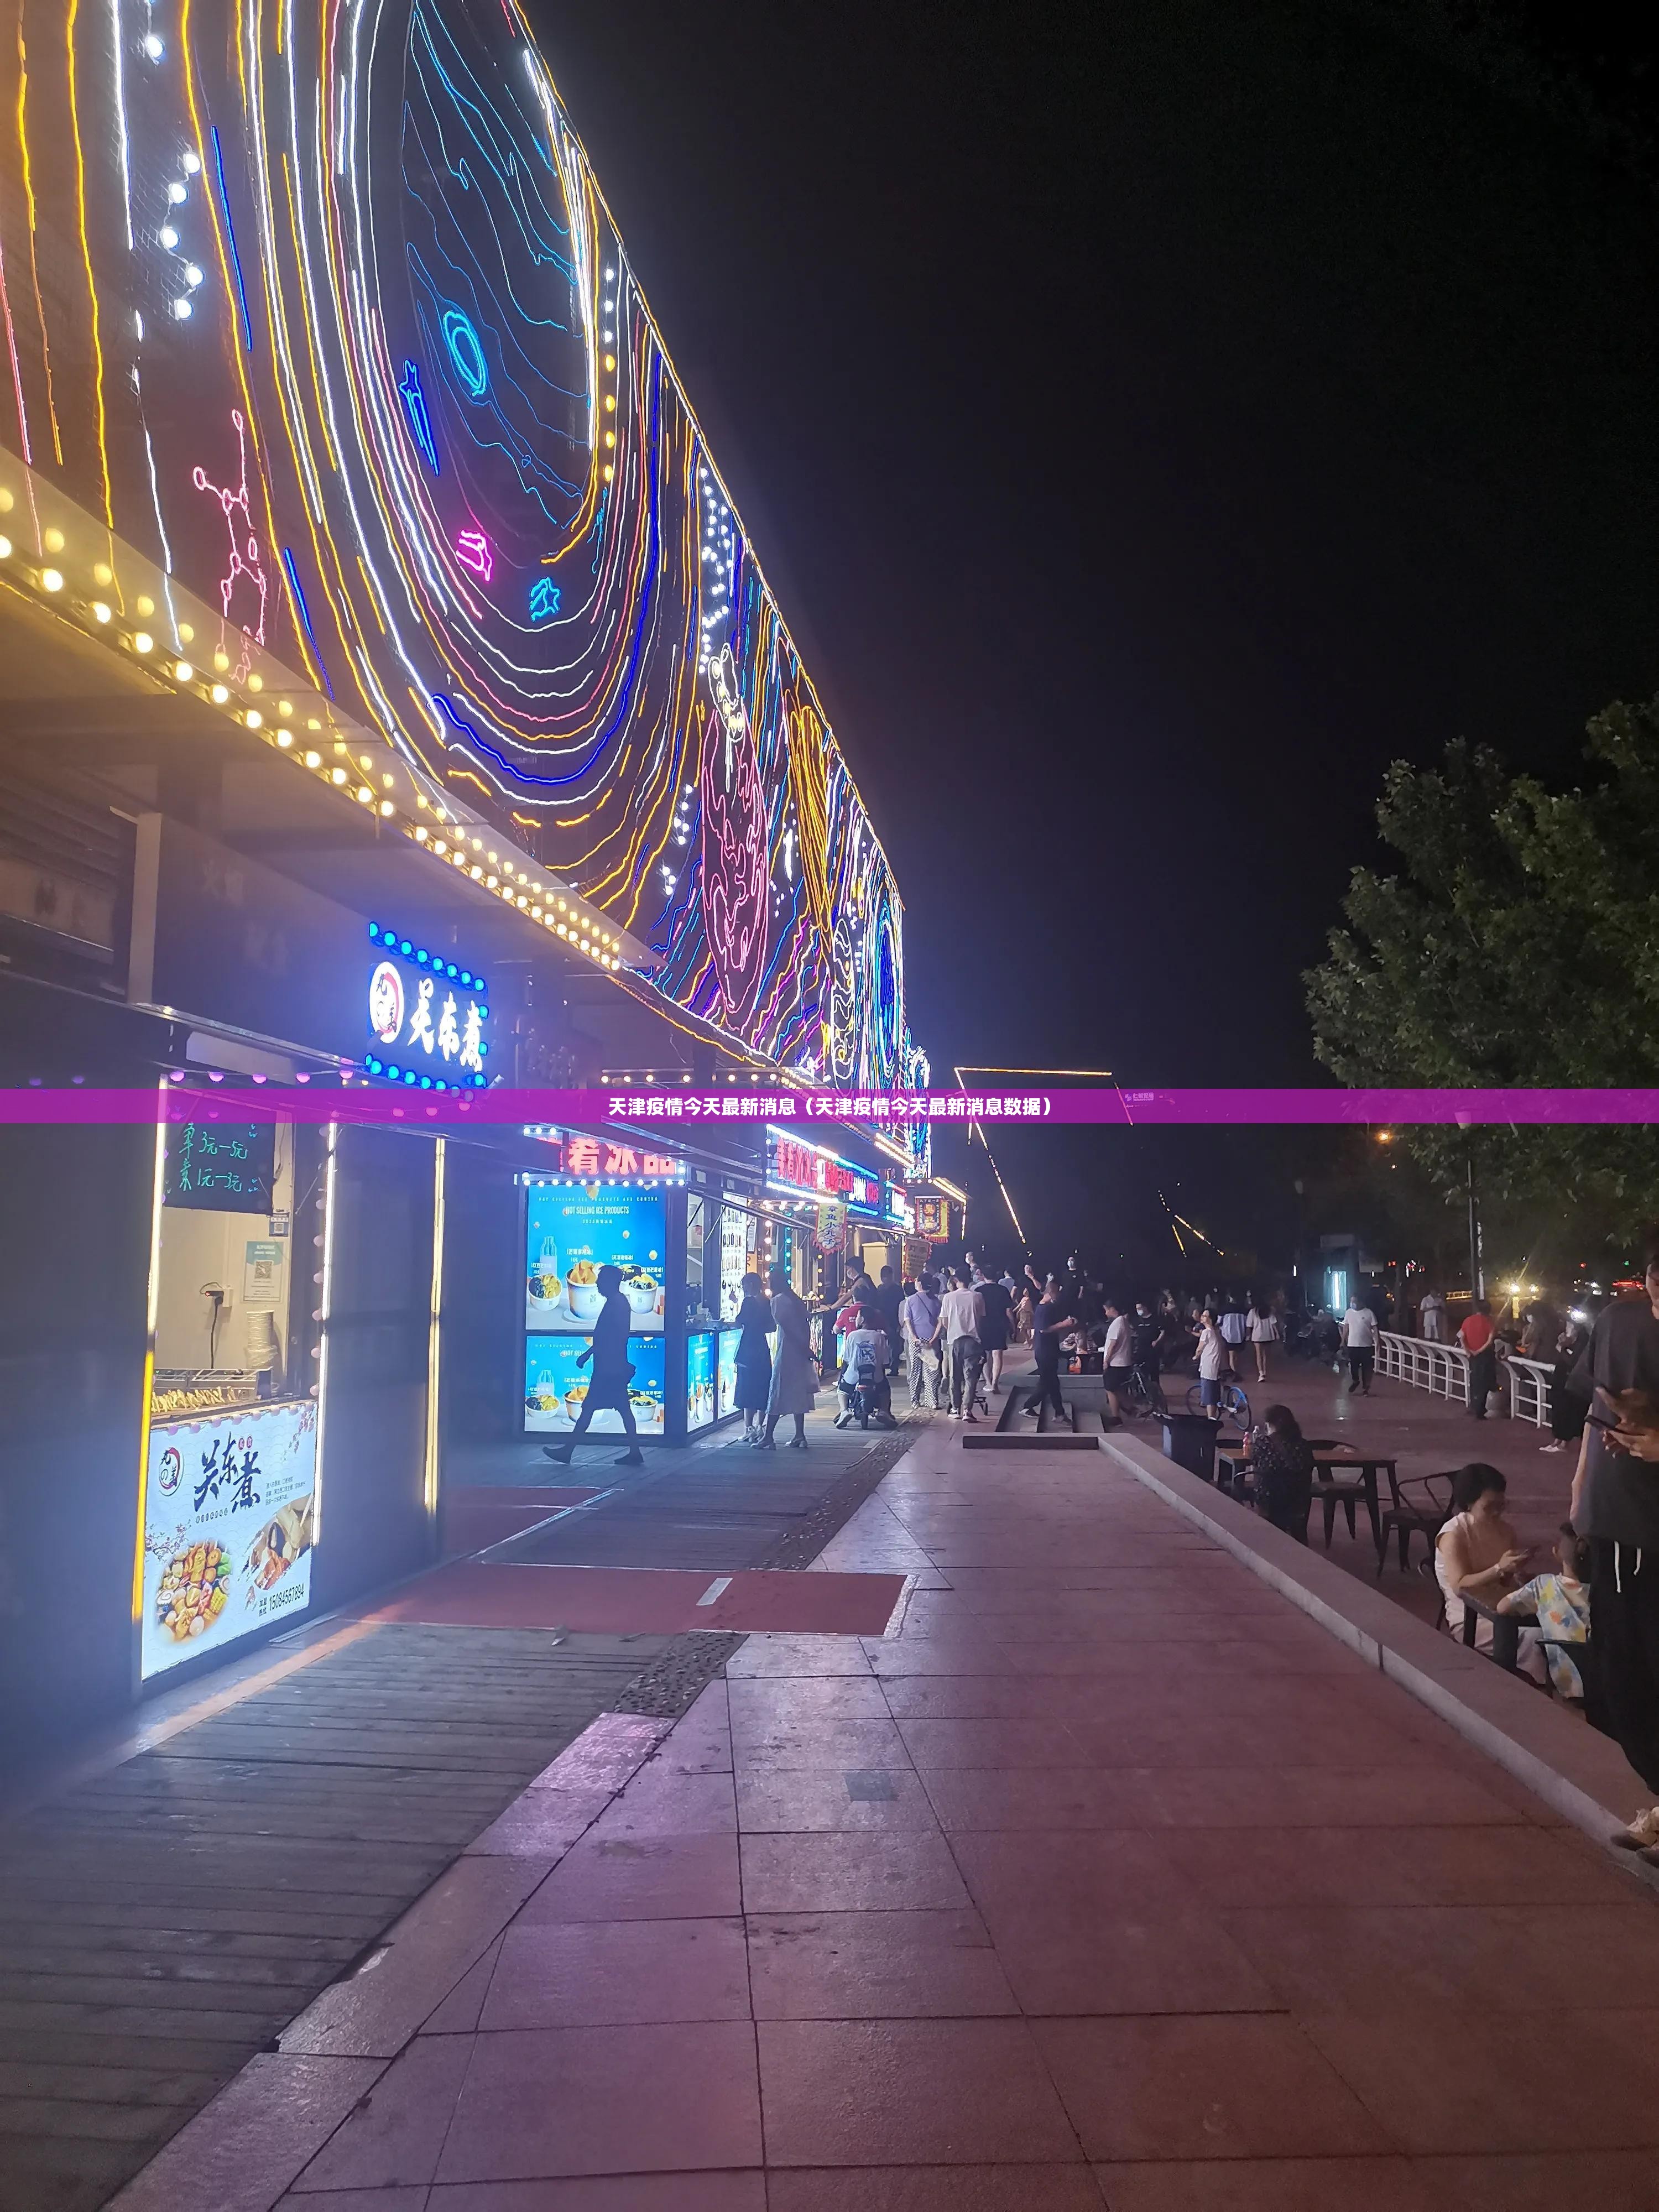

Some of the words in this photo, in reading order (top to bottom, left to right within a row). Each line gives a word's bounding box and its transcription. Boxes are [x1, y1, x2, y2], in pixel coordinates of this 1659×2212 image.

[604, 1206, 629, 1214] PRODUCTS
[194, 1431, 262, 1513] 关东煮
